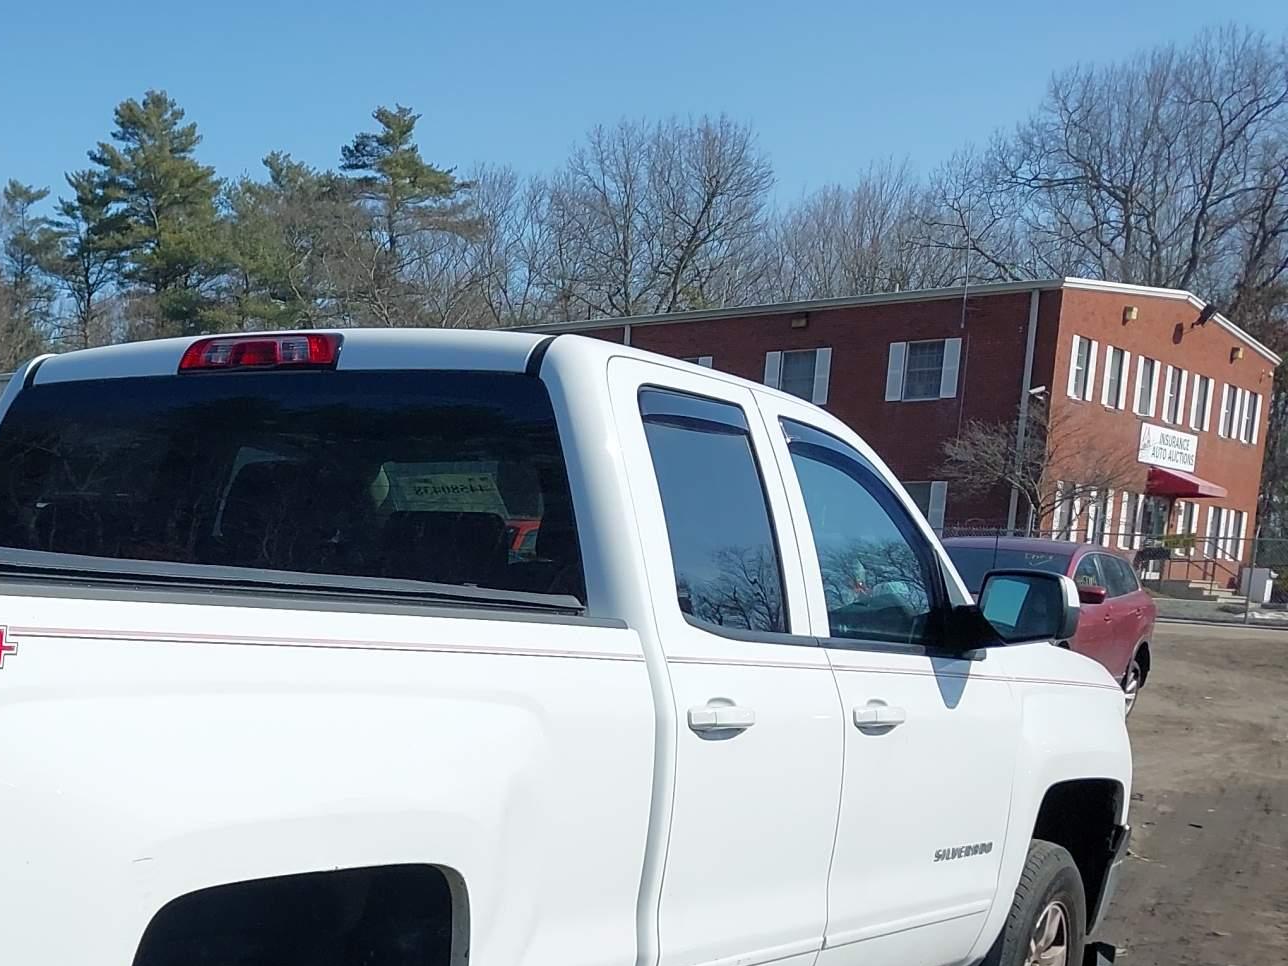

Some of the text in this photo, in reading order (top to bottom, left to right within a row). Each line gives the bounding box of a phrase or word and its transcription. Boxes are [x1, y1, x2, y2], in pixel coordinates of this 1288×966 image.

[1159, 432, 1190, 452] INSURANCE
[1151, 445, 1195, 467] AUTO AUCTIONS
[933, 841, 993, 862] SILVERADO
